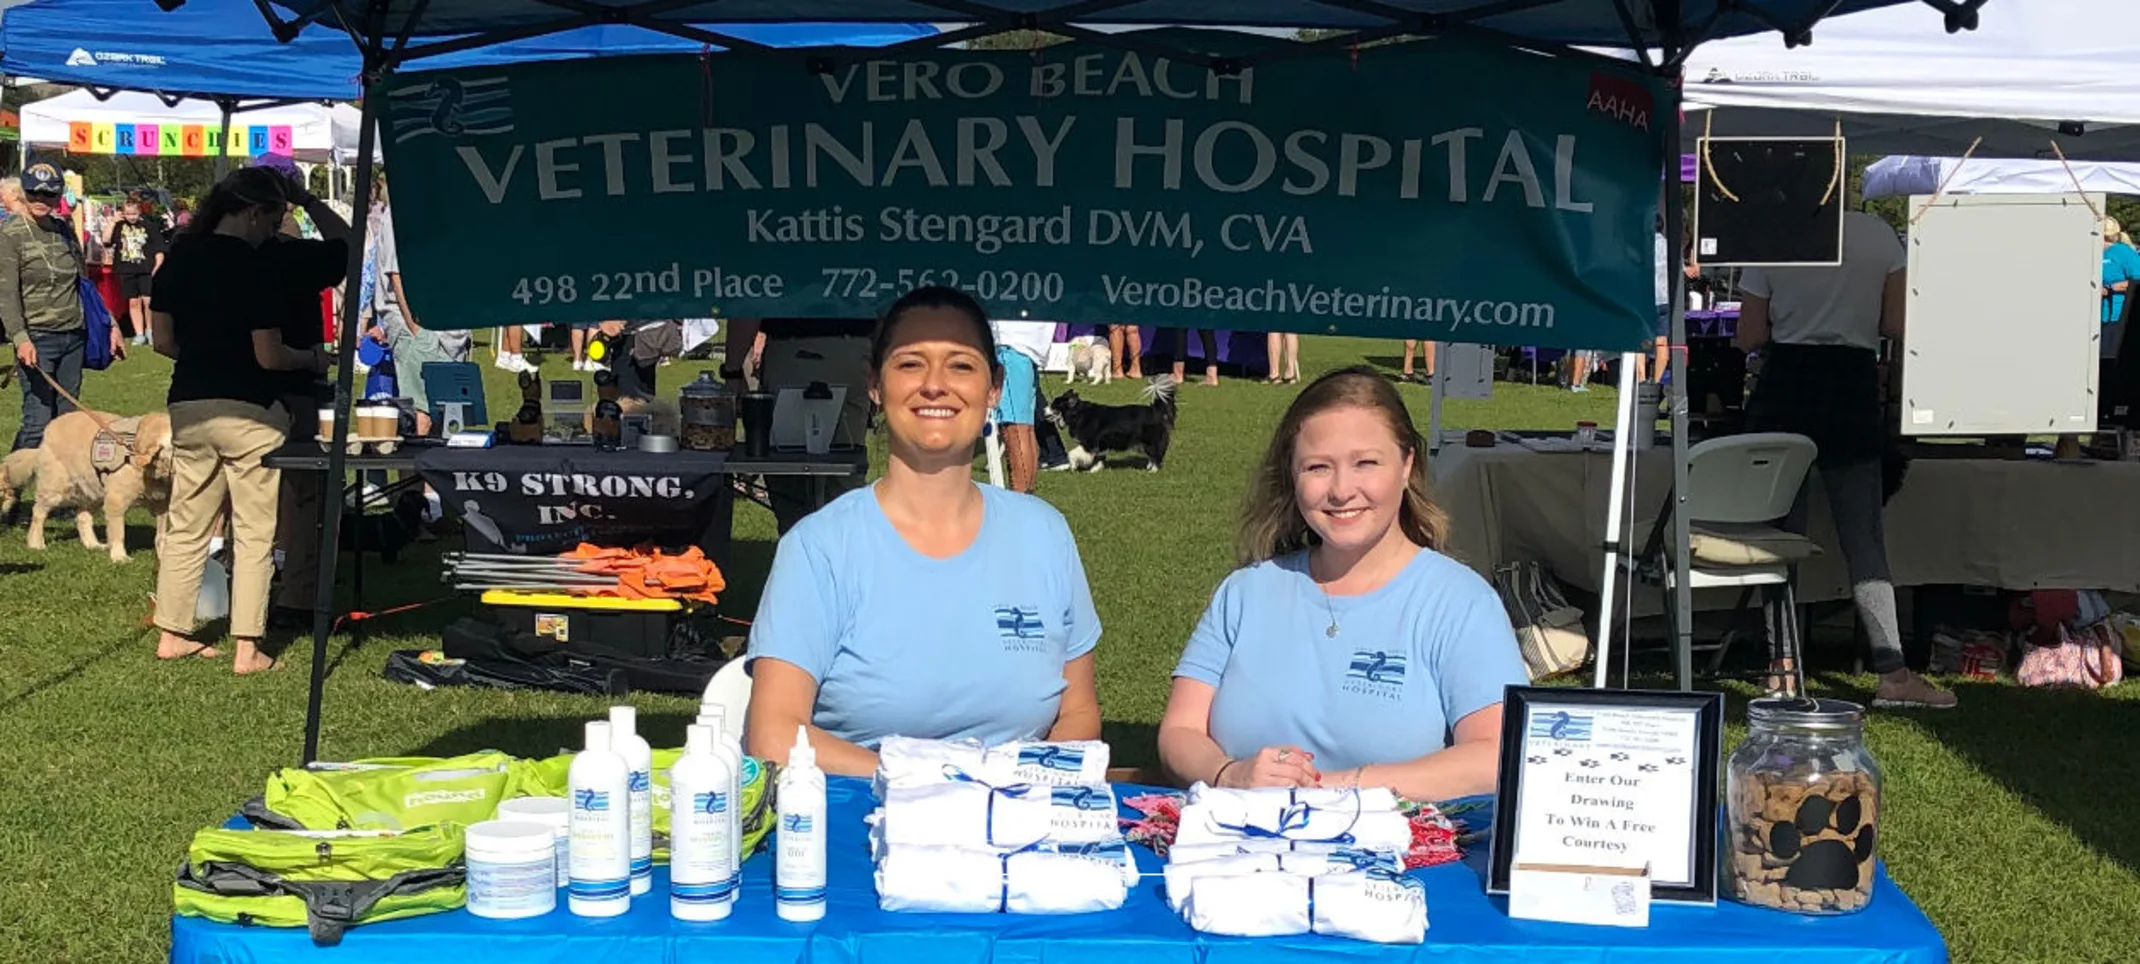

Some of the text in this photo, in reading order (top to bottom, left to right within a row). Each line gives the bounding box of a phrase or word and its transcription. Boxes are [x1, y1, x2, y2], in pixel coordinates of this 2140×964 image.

[95, 51, 133, 62] OZARK
[134, 54, 167, 66] TRAIL
[819, 53, 1254, 105] VERO BEACH
[1586, 87, 1650, 132] AAHA
[75, 129, 287, 149] SCRUNCHIES
[455, 116, 1594, 213] VETERINARY HOSPITAL
[747, 204, 1313, 258] Kattis Stengard DVM, CVA
[512, 262, 1556, 331] 498 22nd Place 772-562-0200 VeroBeachVeterinary.com
[453, 472, 695, 499] K9 STRONG,
[537, 501, 617, 525] INC.
[1342, 685, 1402, 701] HOSPITAL
[1565, 772, 1641, 787] Enter Our
[1571, 794, 1635, 811] Drawing
[1051, 819, 1112, 830] HOSPITA
[1546, 814, 1657, 833] To Win A Free
[1562, 836, 1629, 854] Courtesy
